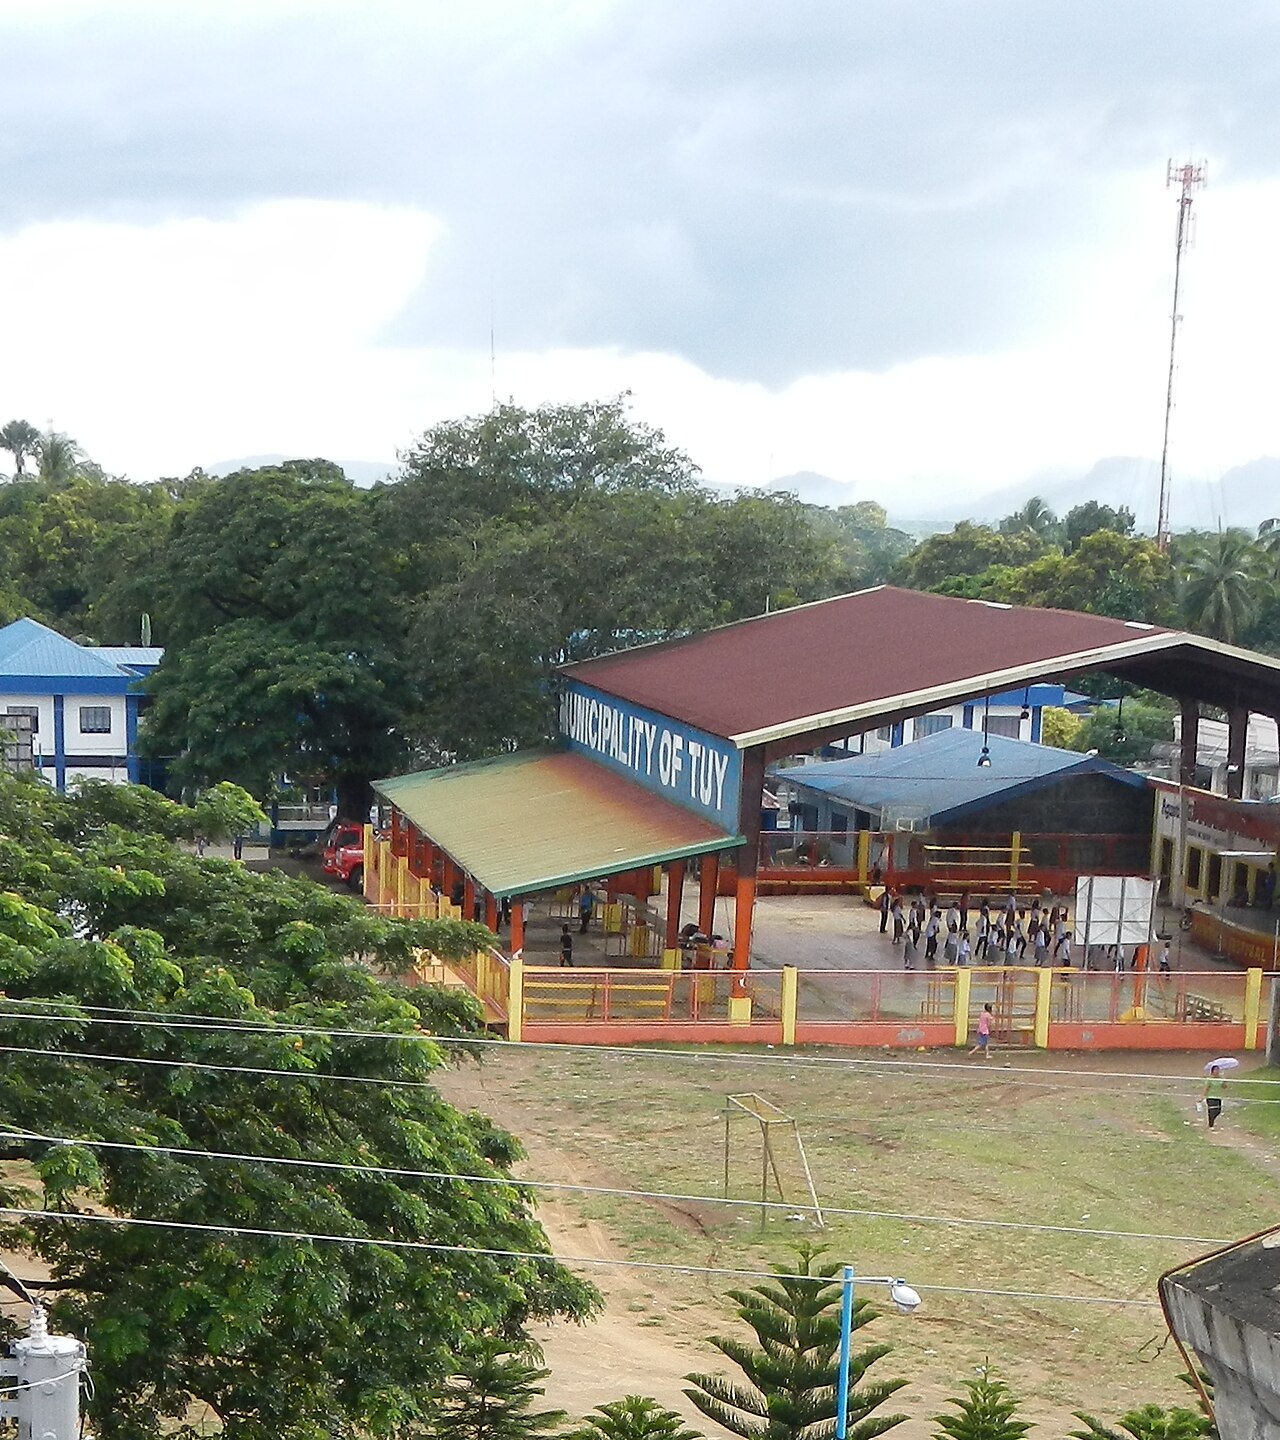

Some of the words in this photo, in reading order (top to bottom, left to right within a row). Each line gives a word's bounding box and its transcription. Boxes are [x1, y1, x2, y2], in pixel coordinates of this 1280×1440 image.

[558, 692, 657, 776] MUNICIPALITY
[658, 728, 684, 788] OF
[688, 740, 729, 811] TUY
